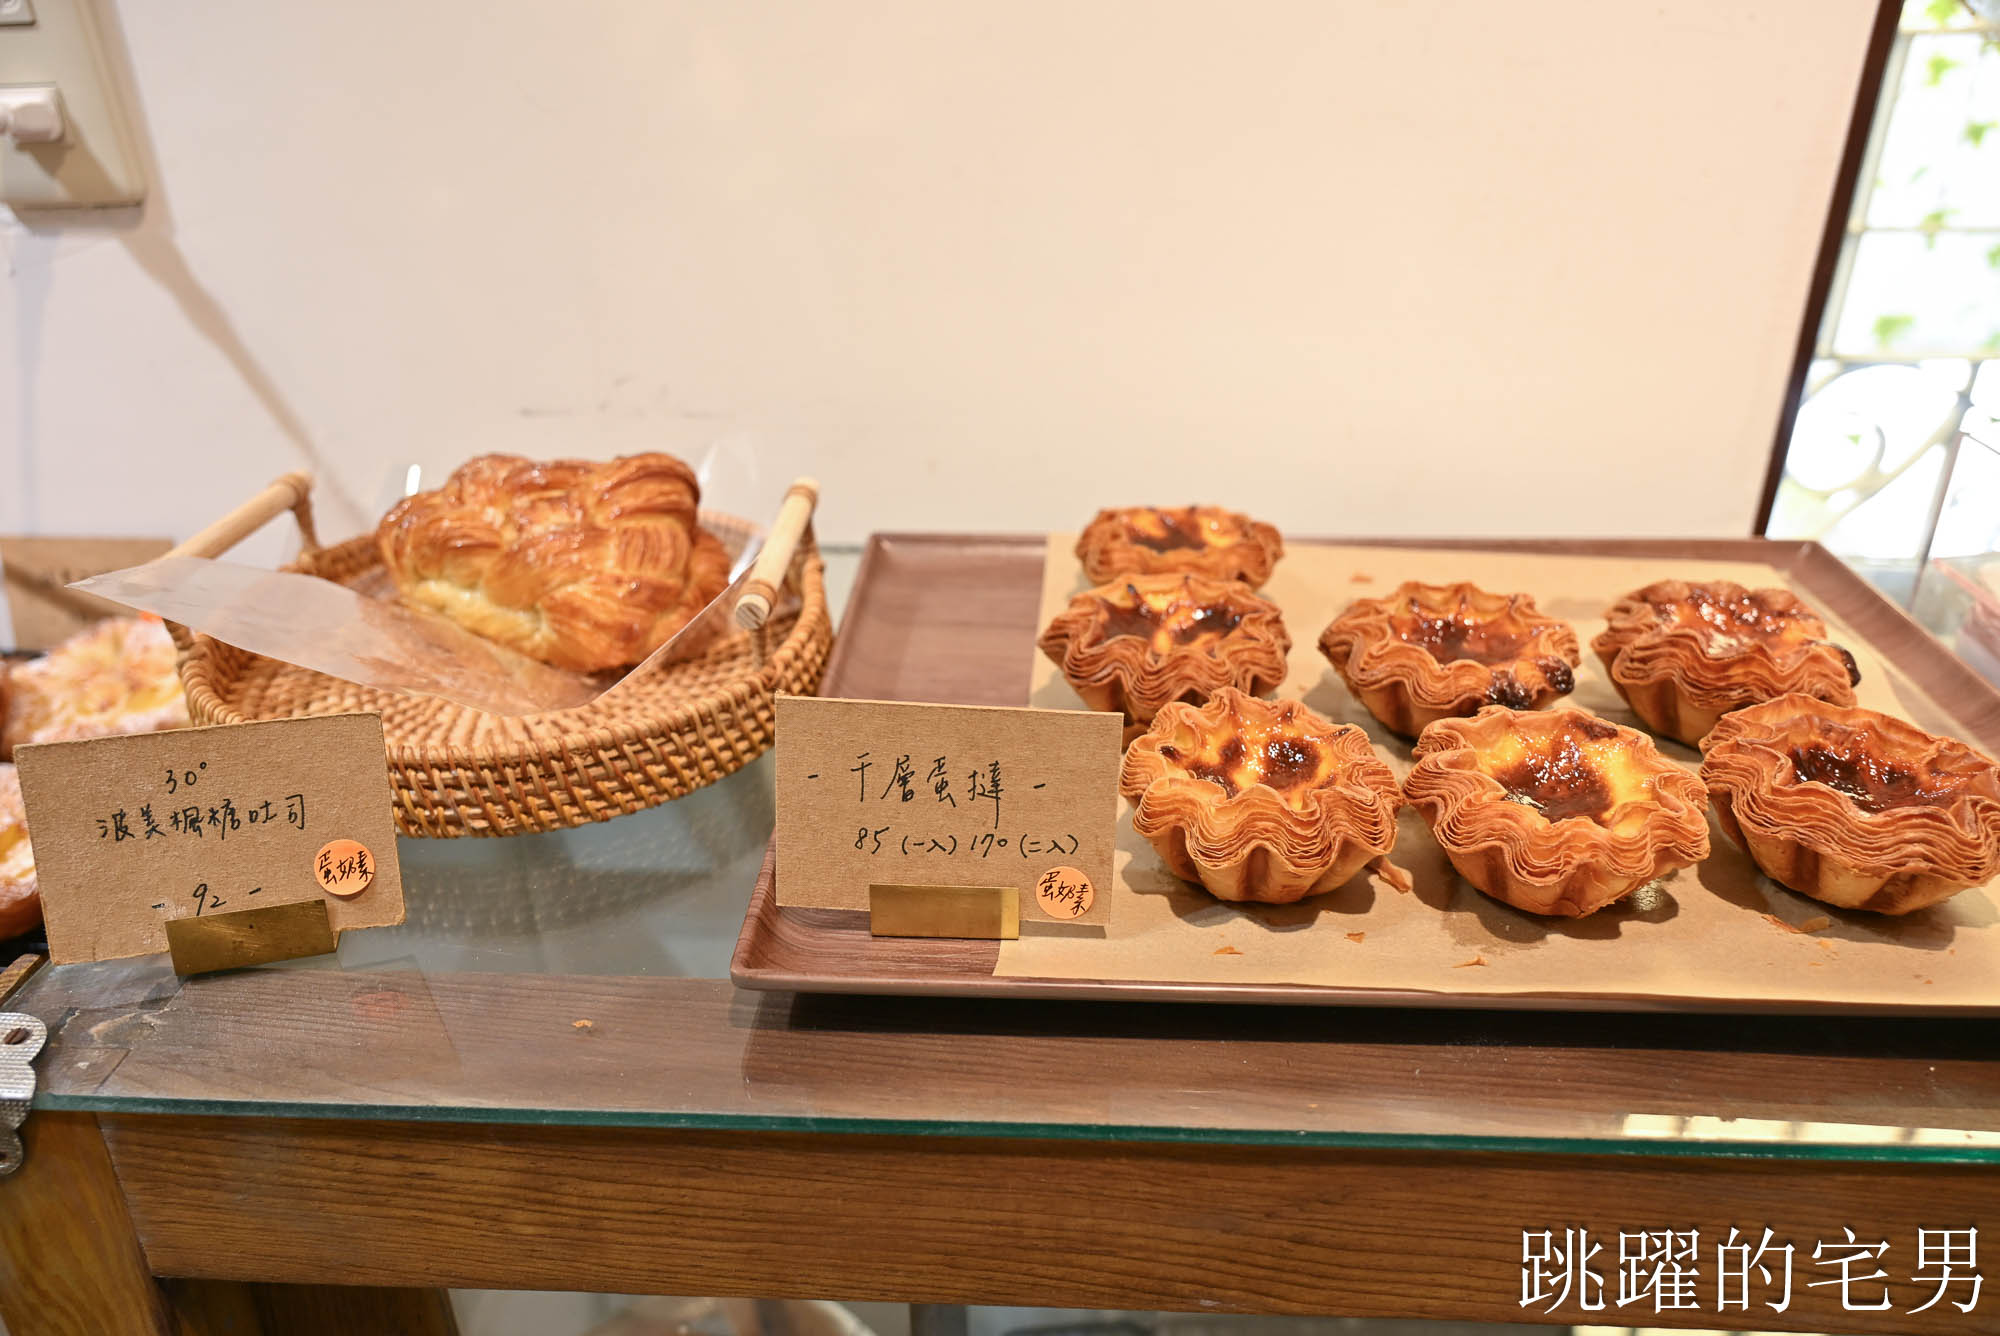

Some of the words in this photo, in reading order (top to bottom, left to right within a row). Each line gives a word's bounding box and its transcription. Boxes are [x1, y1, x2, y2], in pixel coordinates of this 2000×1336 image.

[95, 793, 306, 842] 波美楓糖吐司
[854, 827, 890, 854] 85
[970, 834, 1008, 858] 170
[318, 849, 375, 886] 蛋奶素
[1039, 871, 1090, 915] 蛋奶素
